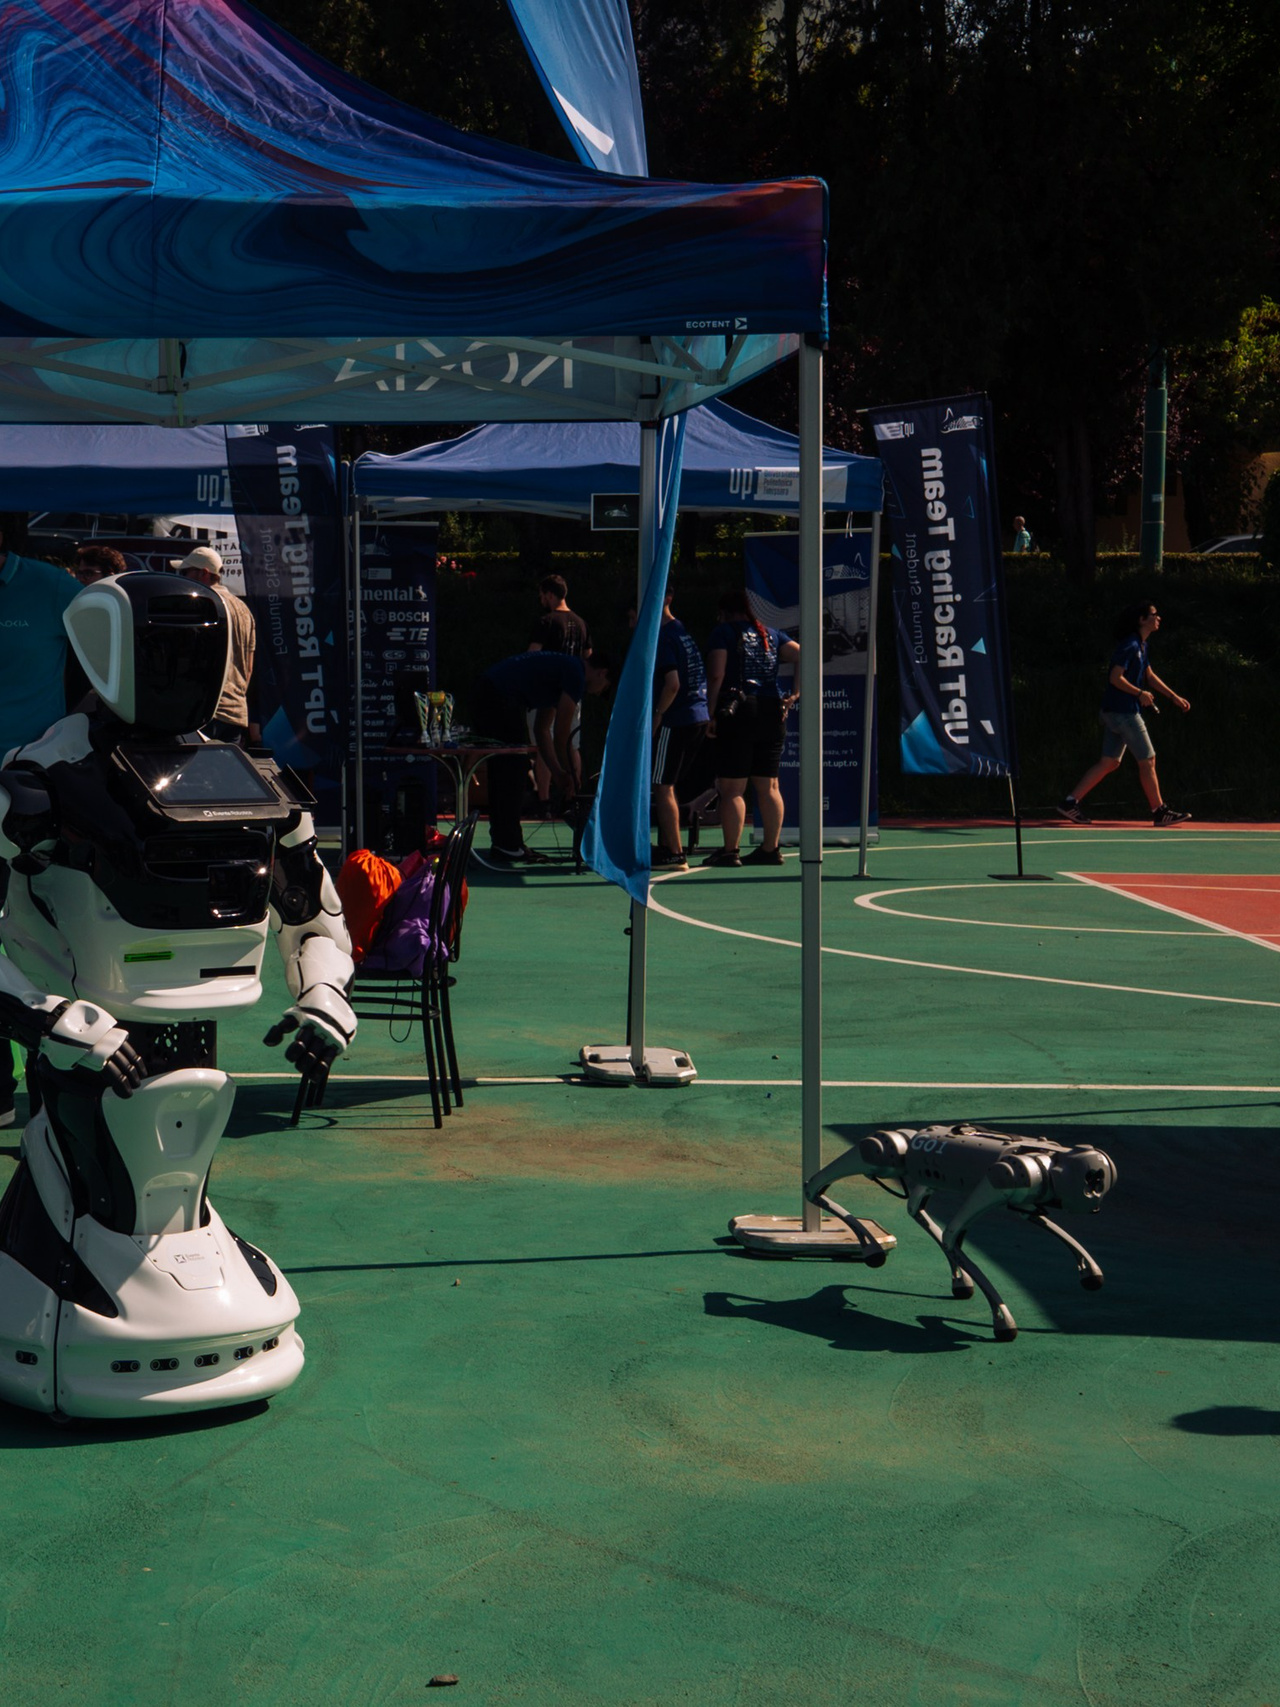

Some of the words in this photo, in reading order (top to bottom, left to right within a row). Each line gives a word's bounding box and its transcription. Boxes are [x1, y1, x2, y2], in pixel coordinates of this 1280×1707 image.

[685, 320, 731, 329] ECOTENT
[388, 611, 430, 622] BOSCH
[408, 628, 429, 643] TE
[911, 1133, 948, 1155] Go1
